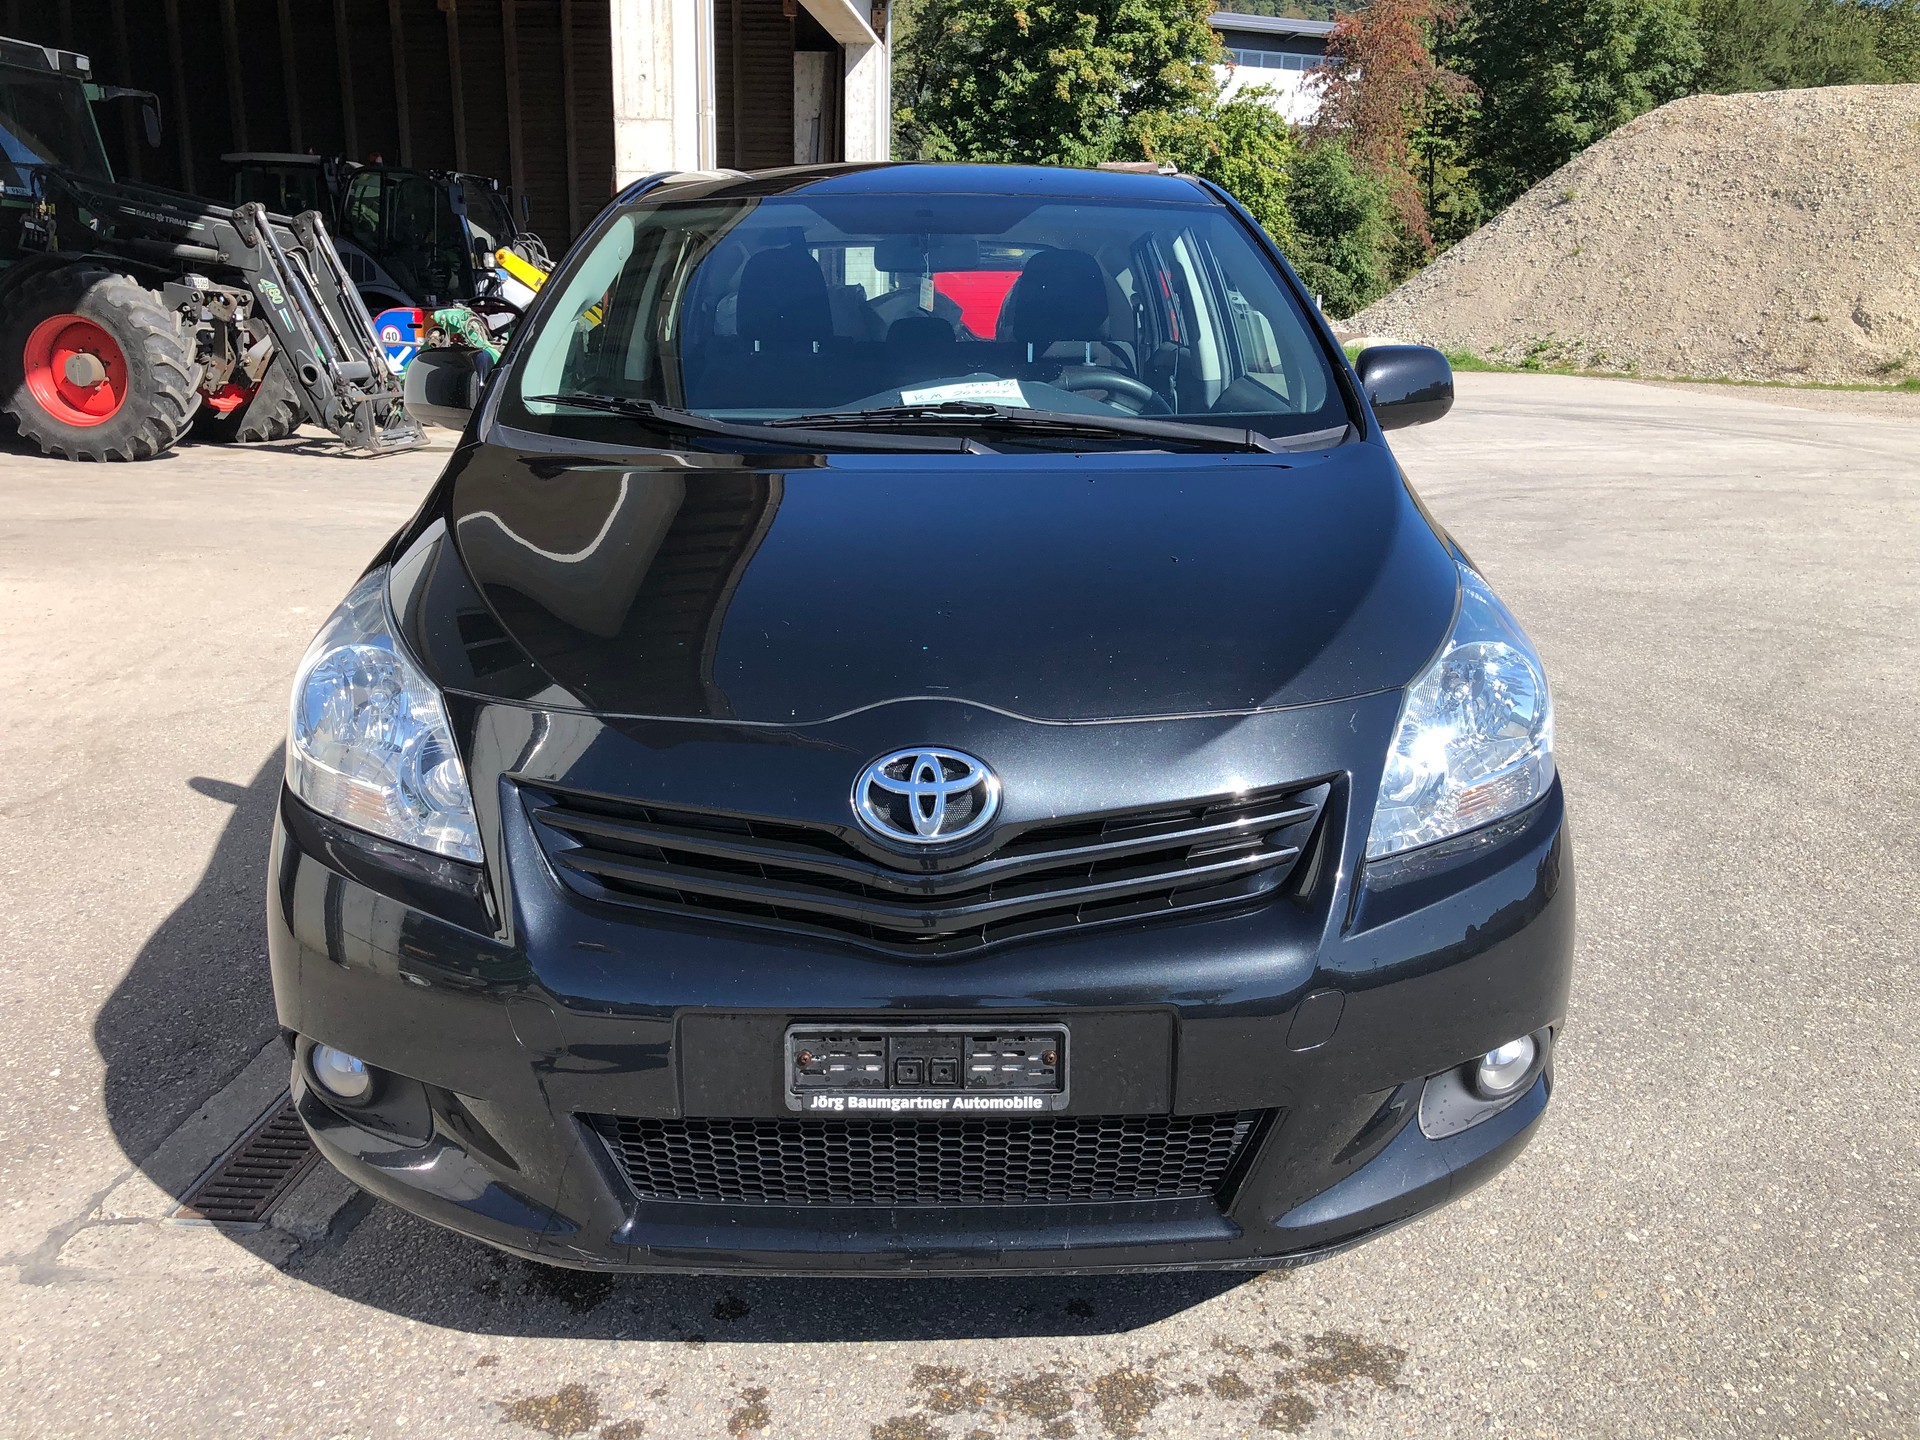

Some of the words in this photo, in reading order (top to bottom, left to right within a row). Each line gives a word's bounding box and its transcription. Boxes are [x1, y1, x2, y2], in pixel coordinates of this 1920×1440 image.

[164, 215, 187, 227] TRIMA
[385, 331, 398, 342] 40
[810, 1095, 844, 1111] Jörg
[847, 1096, 950, 1111] Baumgartner
[952, 1096, 1043, 1109] Automobile
